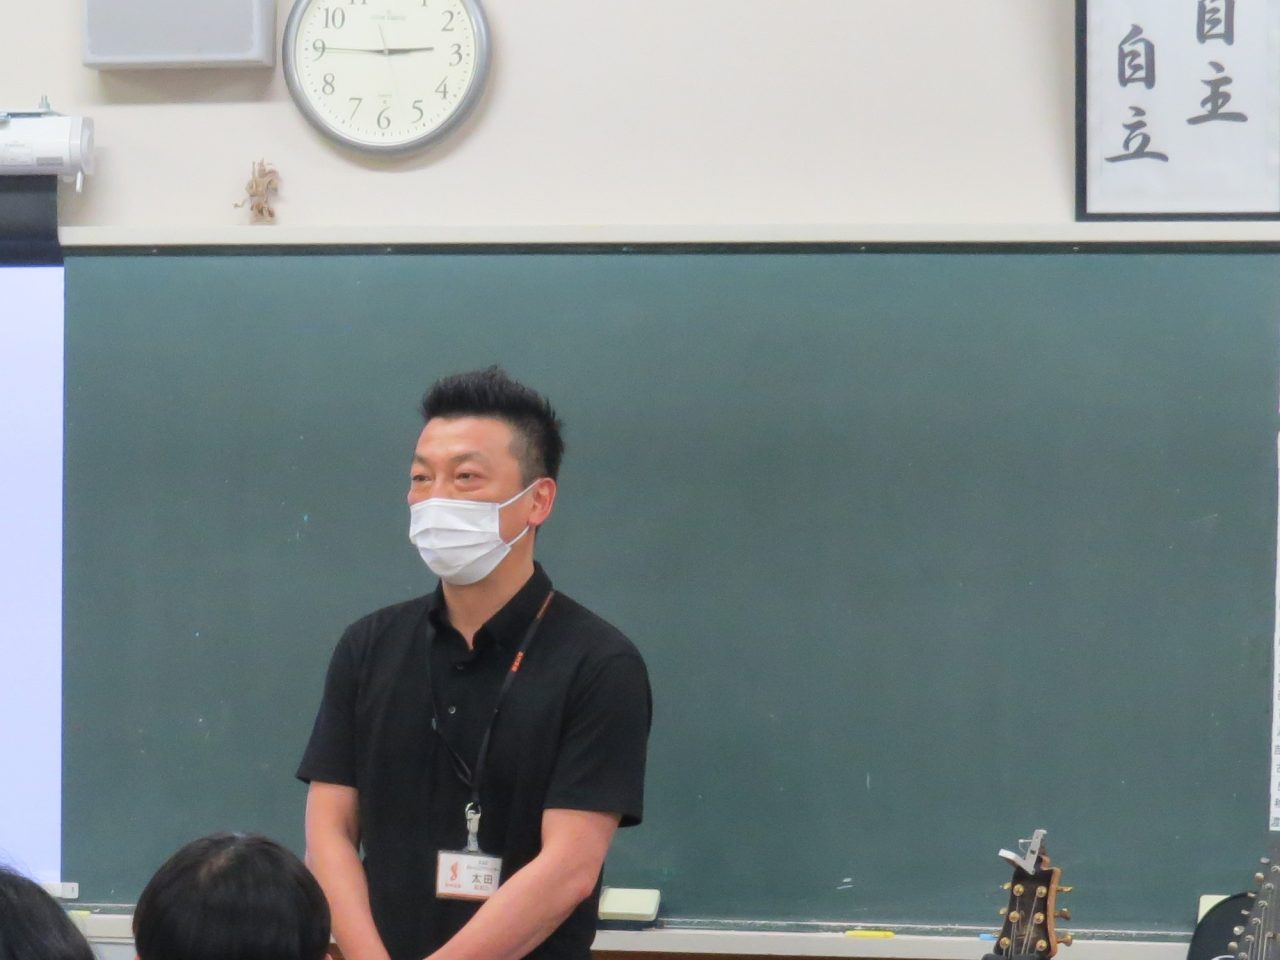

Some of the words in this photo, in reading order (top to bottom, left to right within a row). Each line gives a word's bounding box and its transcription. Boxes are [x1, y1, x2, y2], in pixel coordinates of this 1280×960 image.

[323, 7, 346, 29] 10
[441, 10, 455, 32] 2
[312, 38, 327, 62] 9
[449, 43, 463, 67] 3
[1186, 0, 1249, 126] 自主
[322, 73, 336, 96] 8
[435, 76, 449, 100] 4
[1104, 24, 1169, 163] 自立
[348, 97, 363, 121] 7
[376, 106, 391, 130] 6
[411, 99, 424, 124] 5
